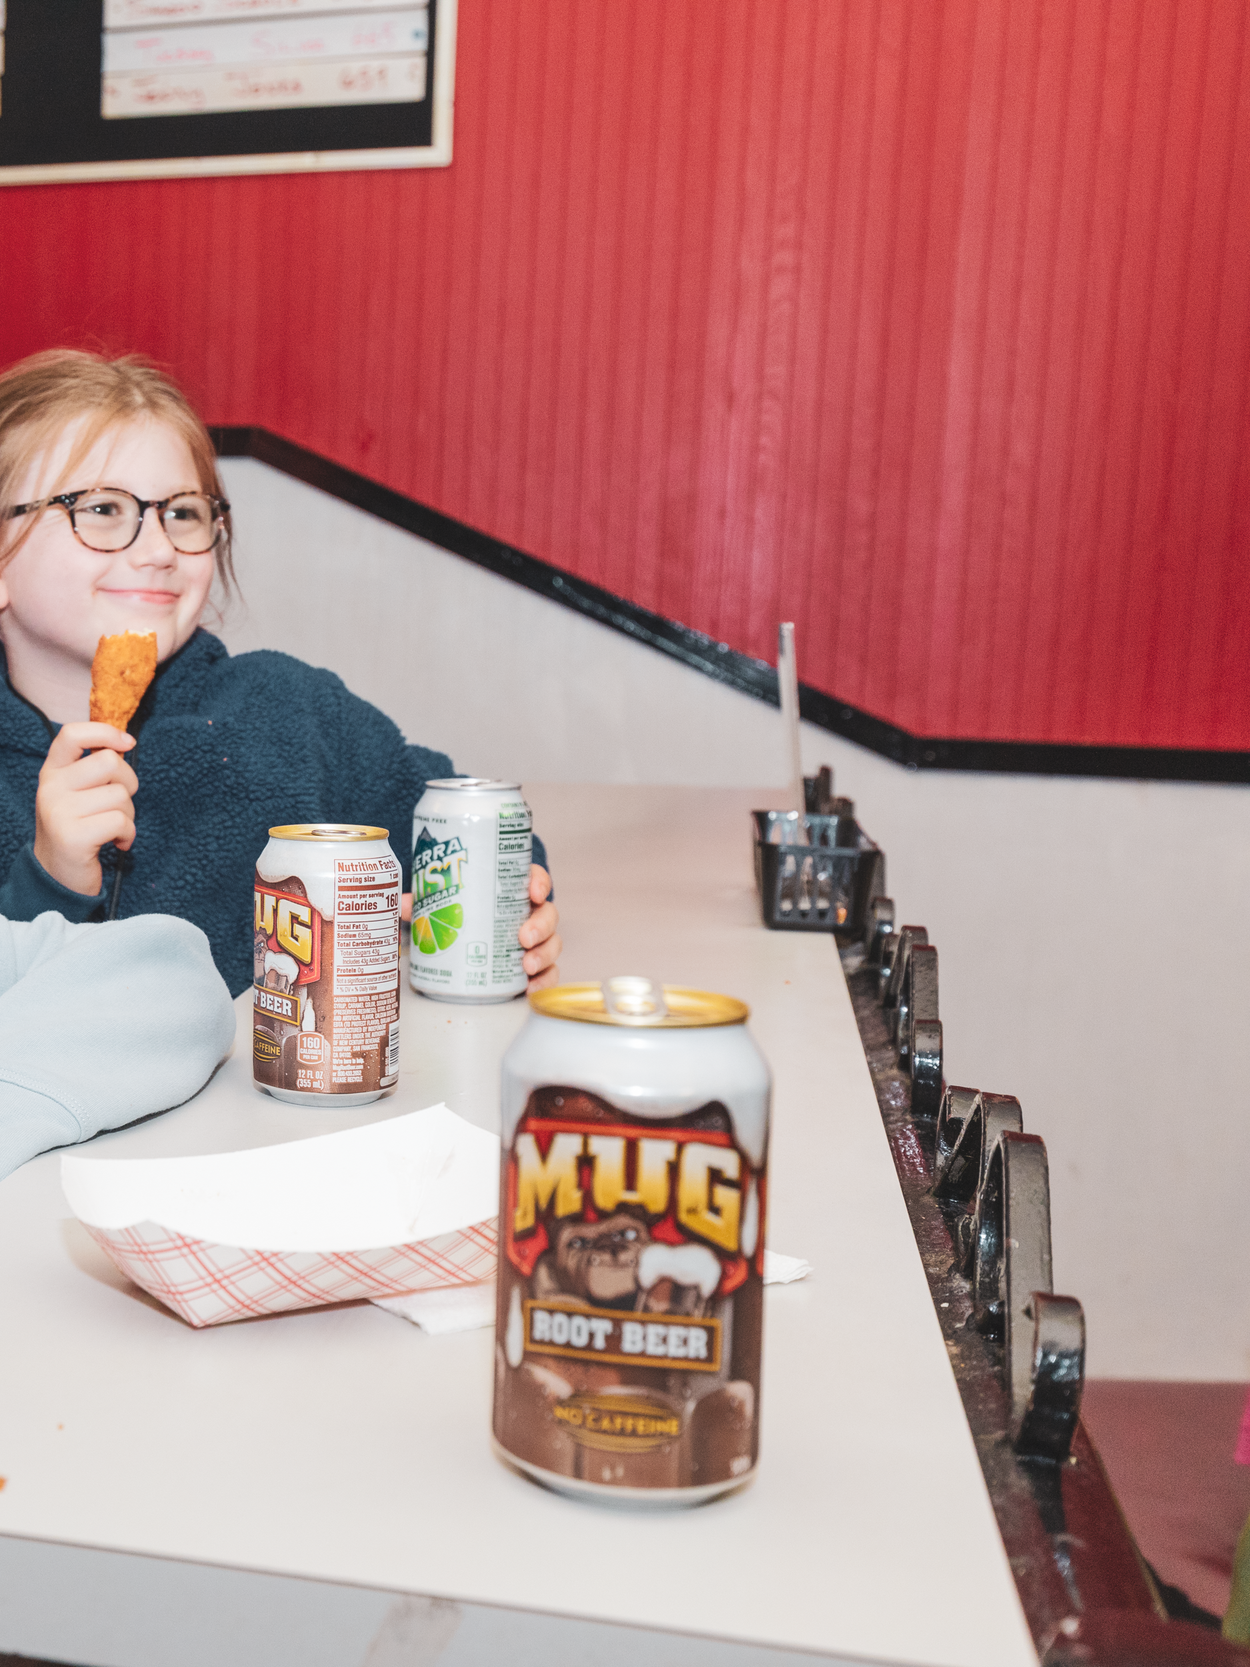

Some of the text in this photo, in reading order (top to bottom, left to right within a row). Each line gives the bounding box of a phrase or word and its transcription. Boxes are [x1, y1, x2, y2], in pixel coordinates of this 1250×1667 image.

[414, 838, 462, 870] ERRA
[498, 842, 524, 851] Calories
[338, 860, 396, 872] Nutrition Facts
[338, 876, 362, 884] Serving
[338, 900, 378, 912] Calories
[386, 893, 398, 908] 160
[422, 886, 456, 907] SUGAR
[254, 891, 312, 964] UG
[352, 939, 384, 948] Carbohydrate
[260, 991, 292, 1017] BEER
[302, 1036, 320, 1049] 160
[296, 1078, 312, 1088] (355
[298, 1070, 324, 1080] 12 FL OZ
[514, 1132, 742, 1254] MUG
[532, 1309, 708, 1360] ROOT BEER
[554, 1404, 680, 1436] NO CAFFEINE
